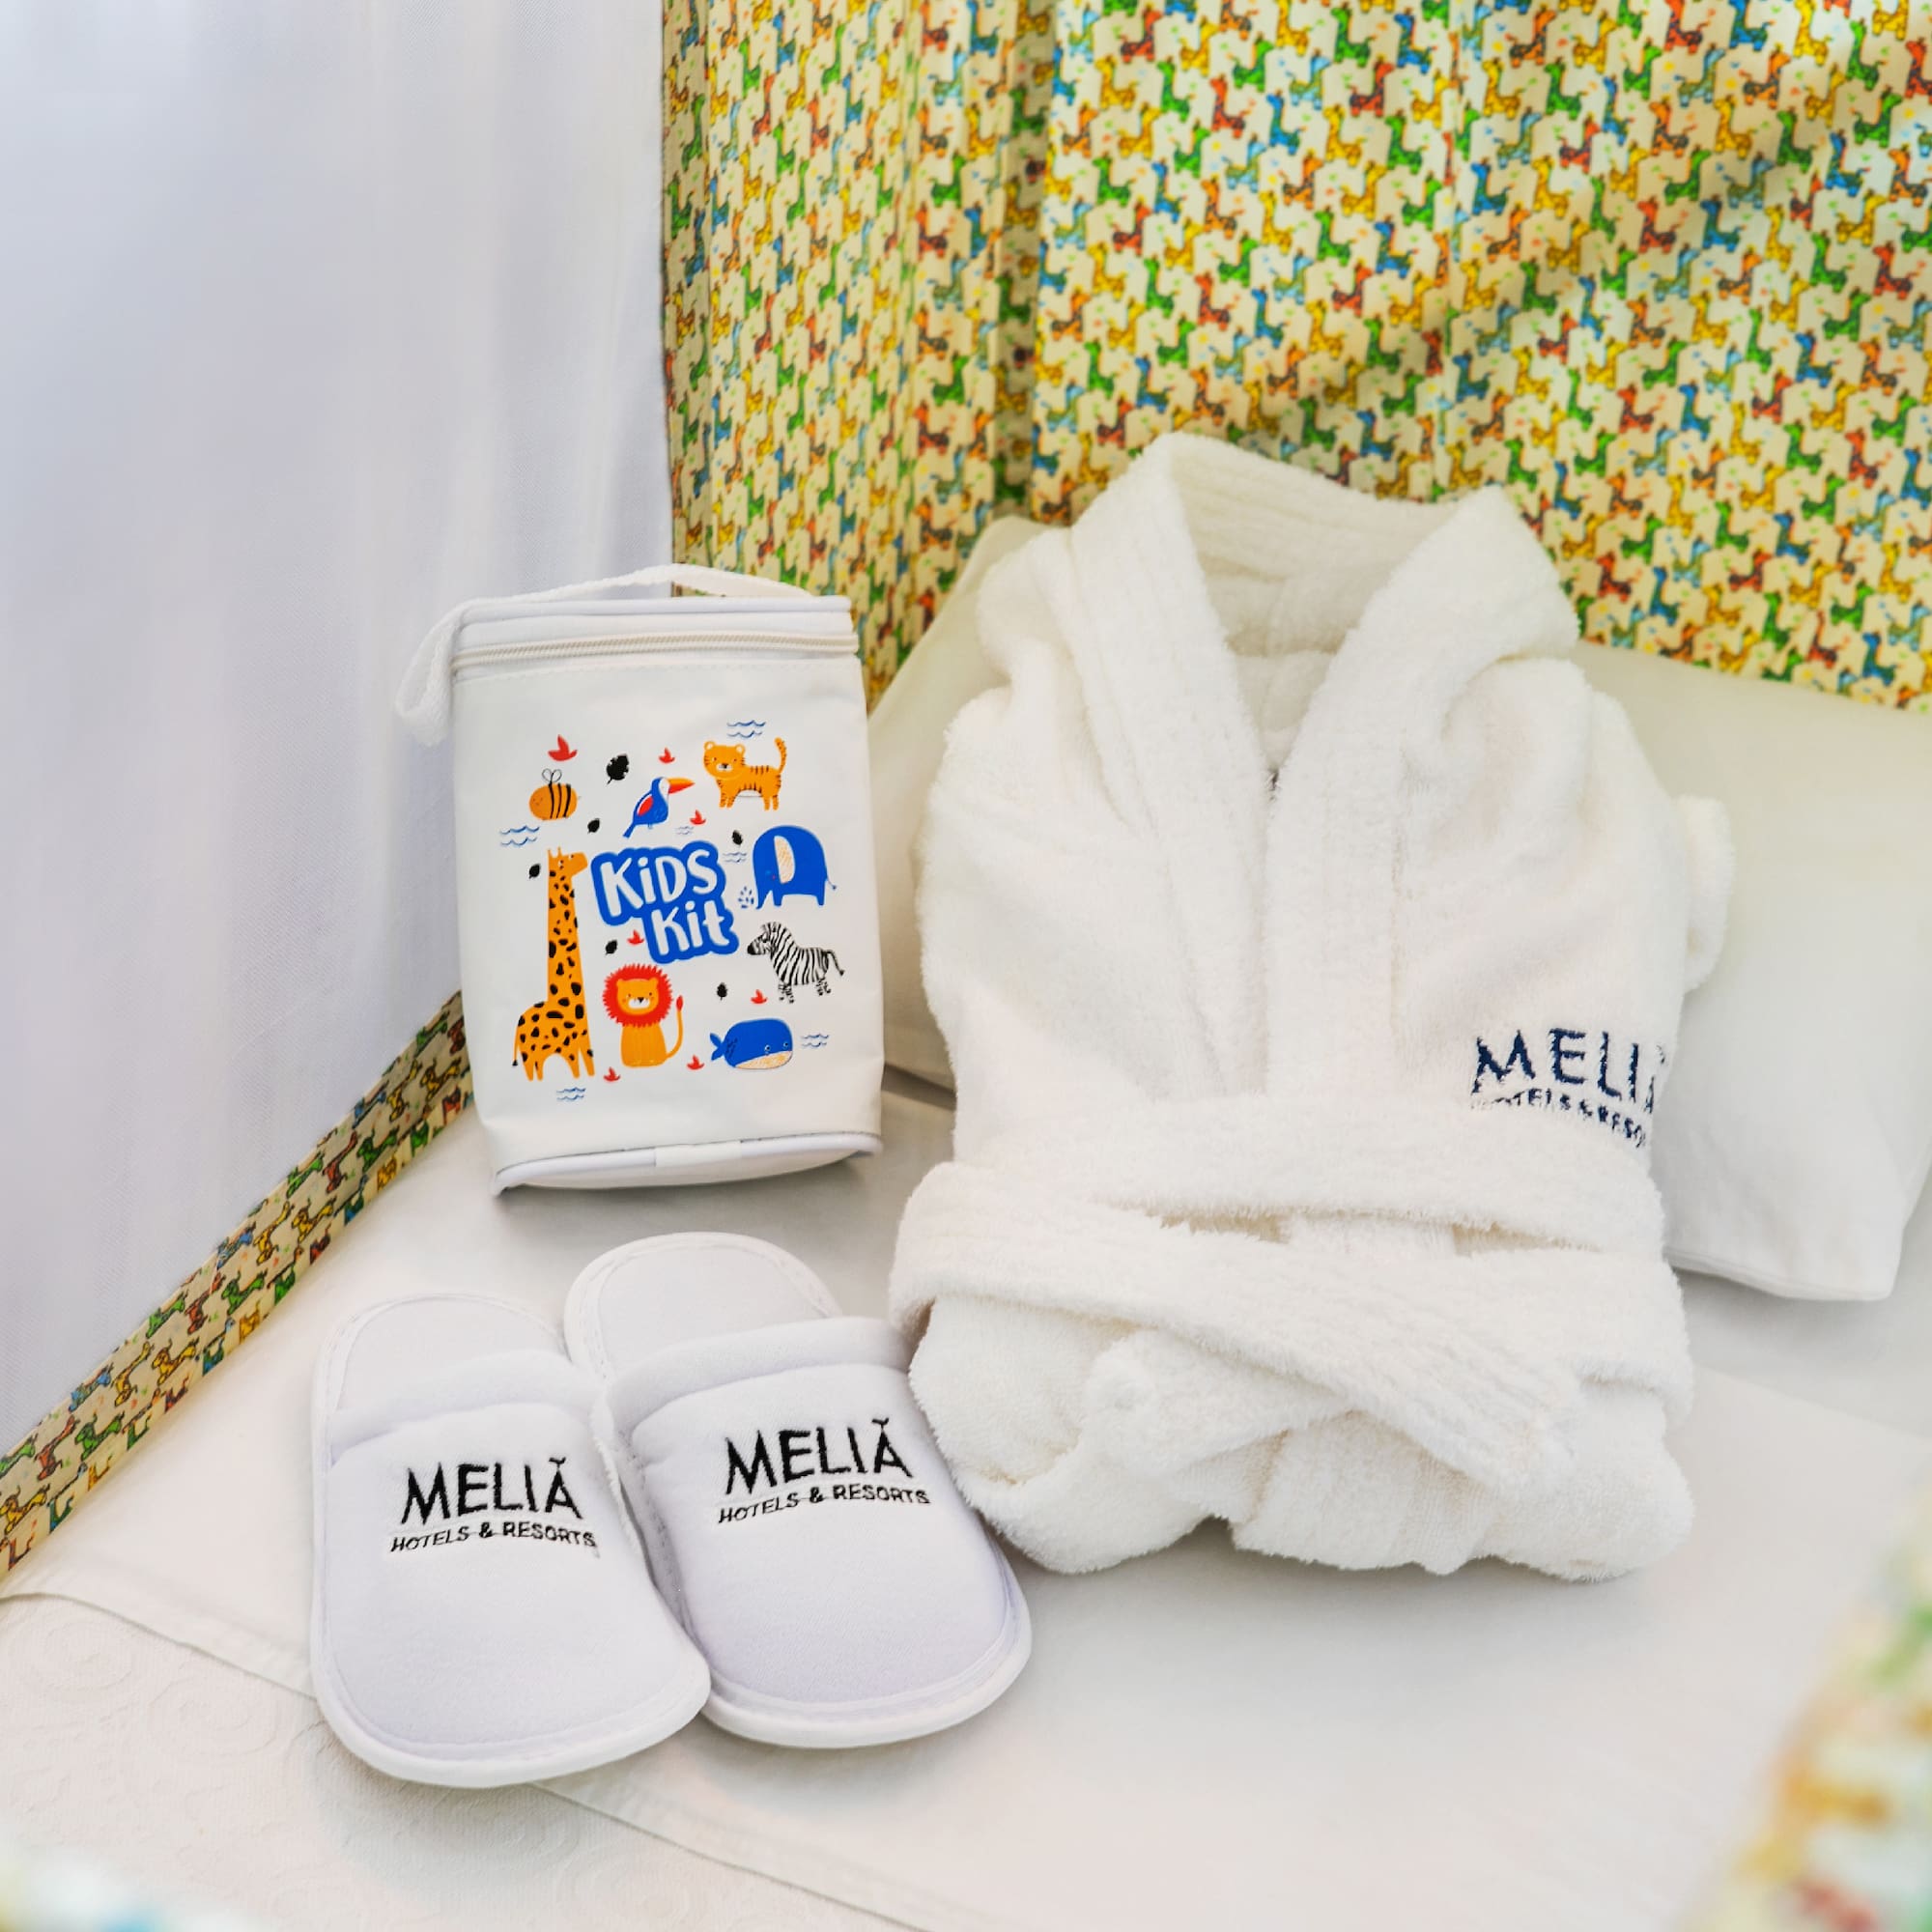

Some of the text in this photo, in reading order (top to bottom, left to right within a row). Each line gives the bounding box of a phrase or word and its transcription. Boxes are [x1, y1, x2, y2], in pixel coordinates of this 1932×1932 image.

[718, 1484, 930, 1523] HOTELS & RESORTS
[390, 1521, 598, 1552] HOTELS & RESORTS
